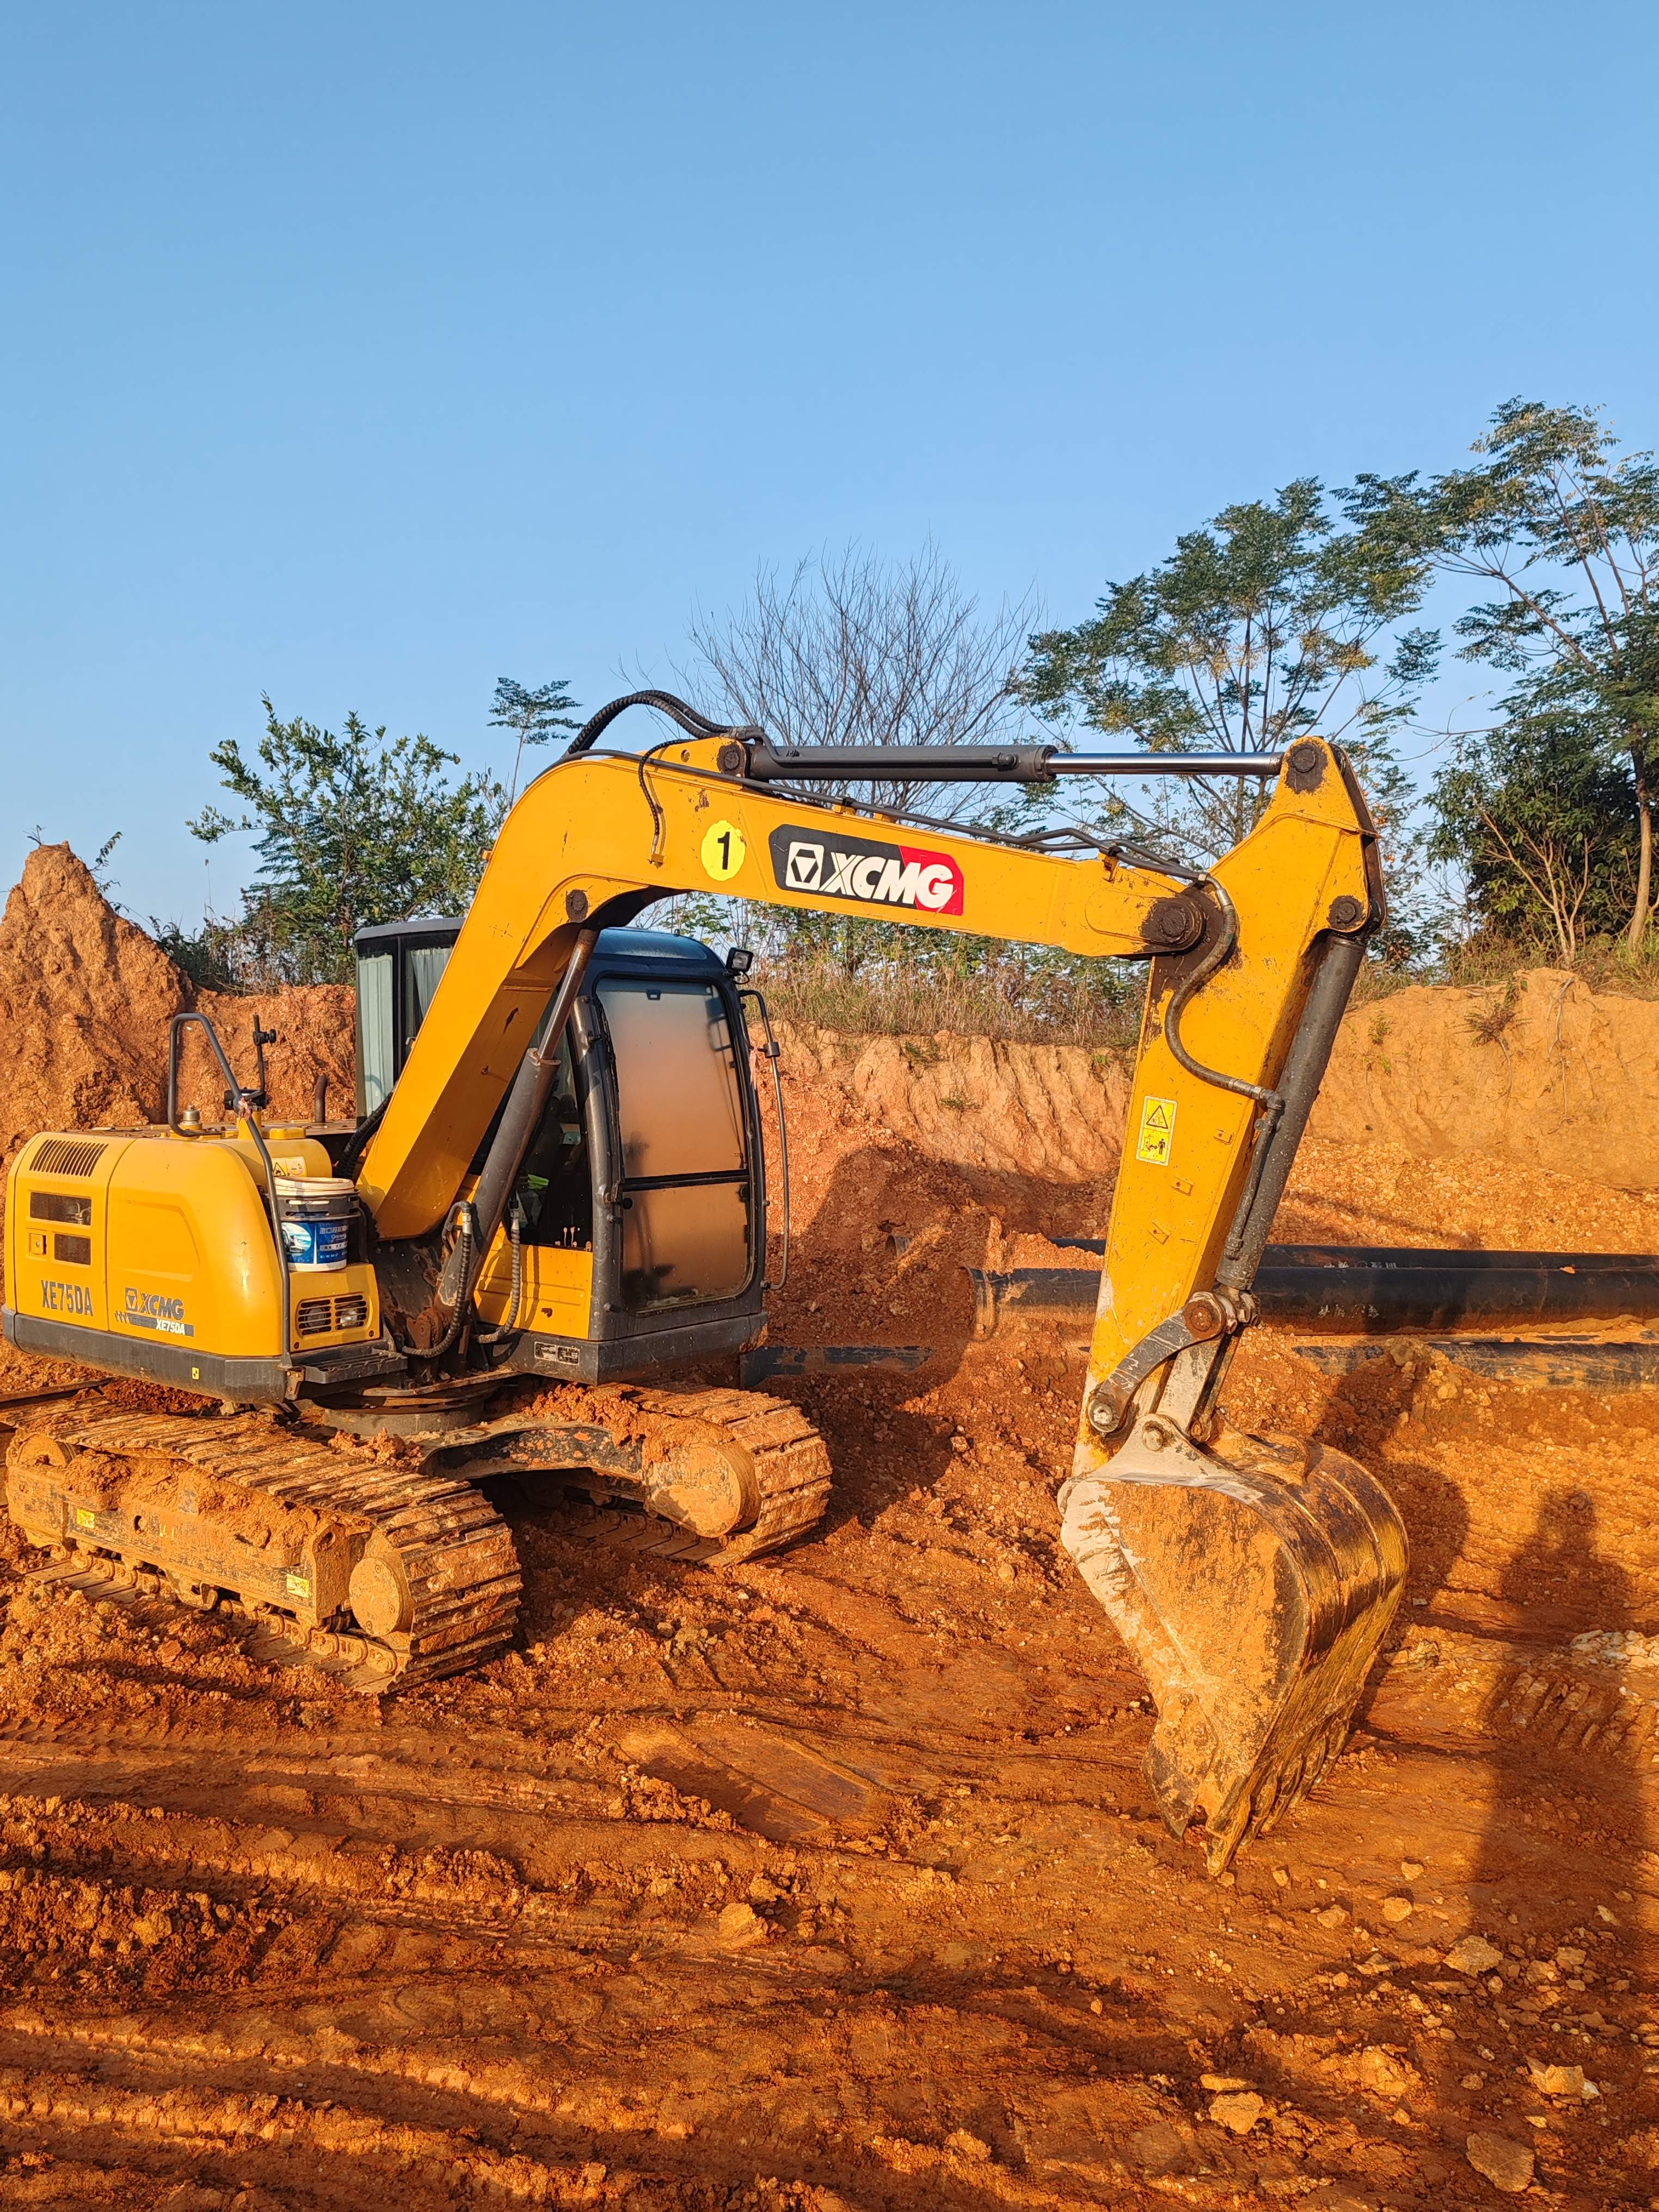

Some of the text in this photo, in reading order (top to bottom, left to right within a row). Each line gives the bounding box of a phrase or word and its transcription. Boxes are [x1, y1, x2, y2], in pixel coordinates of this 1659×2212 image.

[717, 831, 730, 870] 1
[819, 852, 953, 908] XCMG
[41, 1280, 93, 1317] XE75DA
[139, 1293, 183, 1320] XCMG
[156, 1319, 185, 1335] XE75DA
